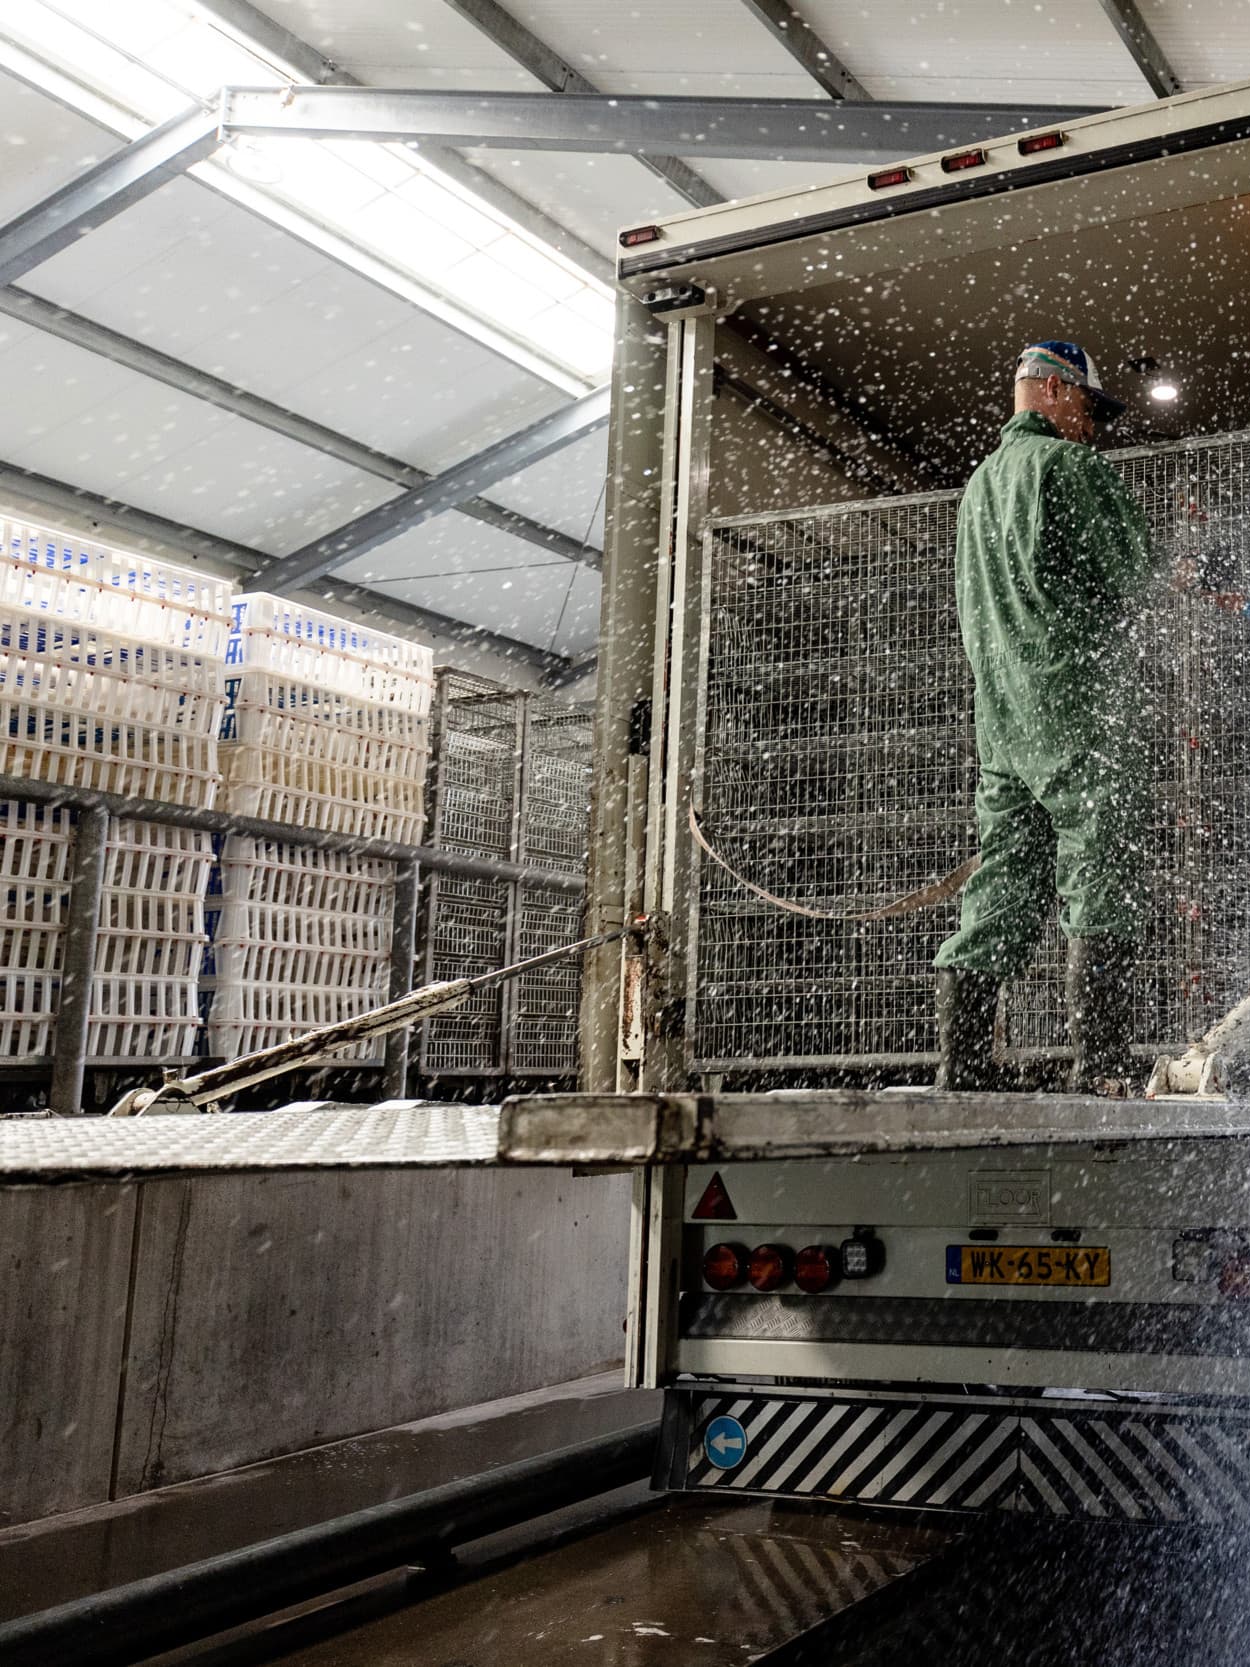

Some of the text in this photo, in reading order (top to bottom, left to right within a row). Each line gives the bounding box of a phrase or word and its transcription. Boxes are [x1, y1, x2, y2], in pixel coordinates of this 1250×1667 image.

[976, 1181, 1041, 1213] FLOOR
[949, 1267, 960, 1277] NL
[971, 1251, 1100, 1281] WK-65-KY
